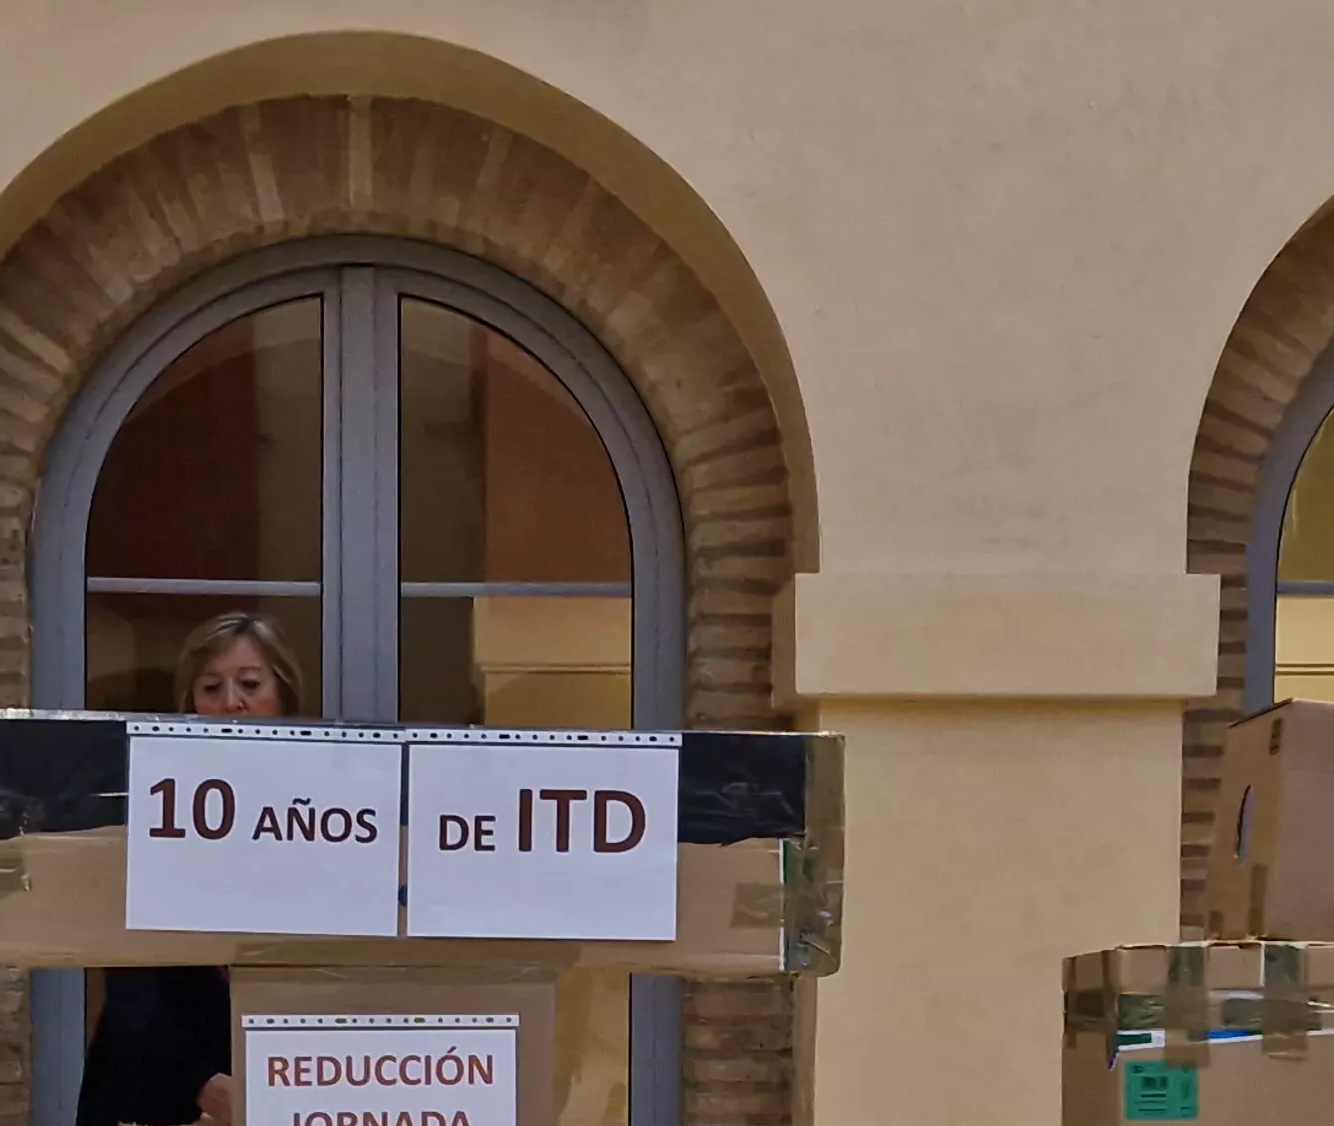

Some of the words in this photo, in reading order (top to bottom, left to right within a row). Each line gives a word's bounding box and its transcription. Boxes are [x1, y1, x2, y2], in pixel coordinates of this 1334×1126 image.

[148, 778, 235, 840] 10
[251, 797, 378, 844] AÑOS
[438, 814, 497, 852] DE
[518, 788, 647, 854] ITD
[267, 1046, 494, 1087] REDUCCIÓN
